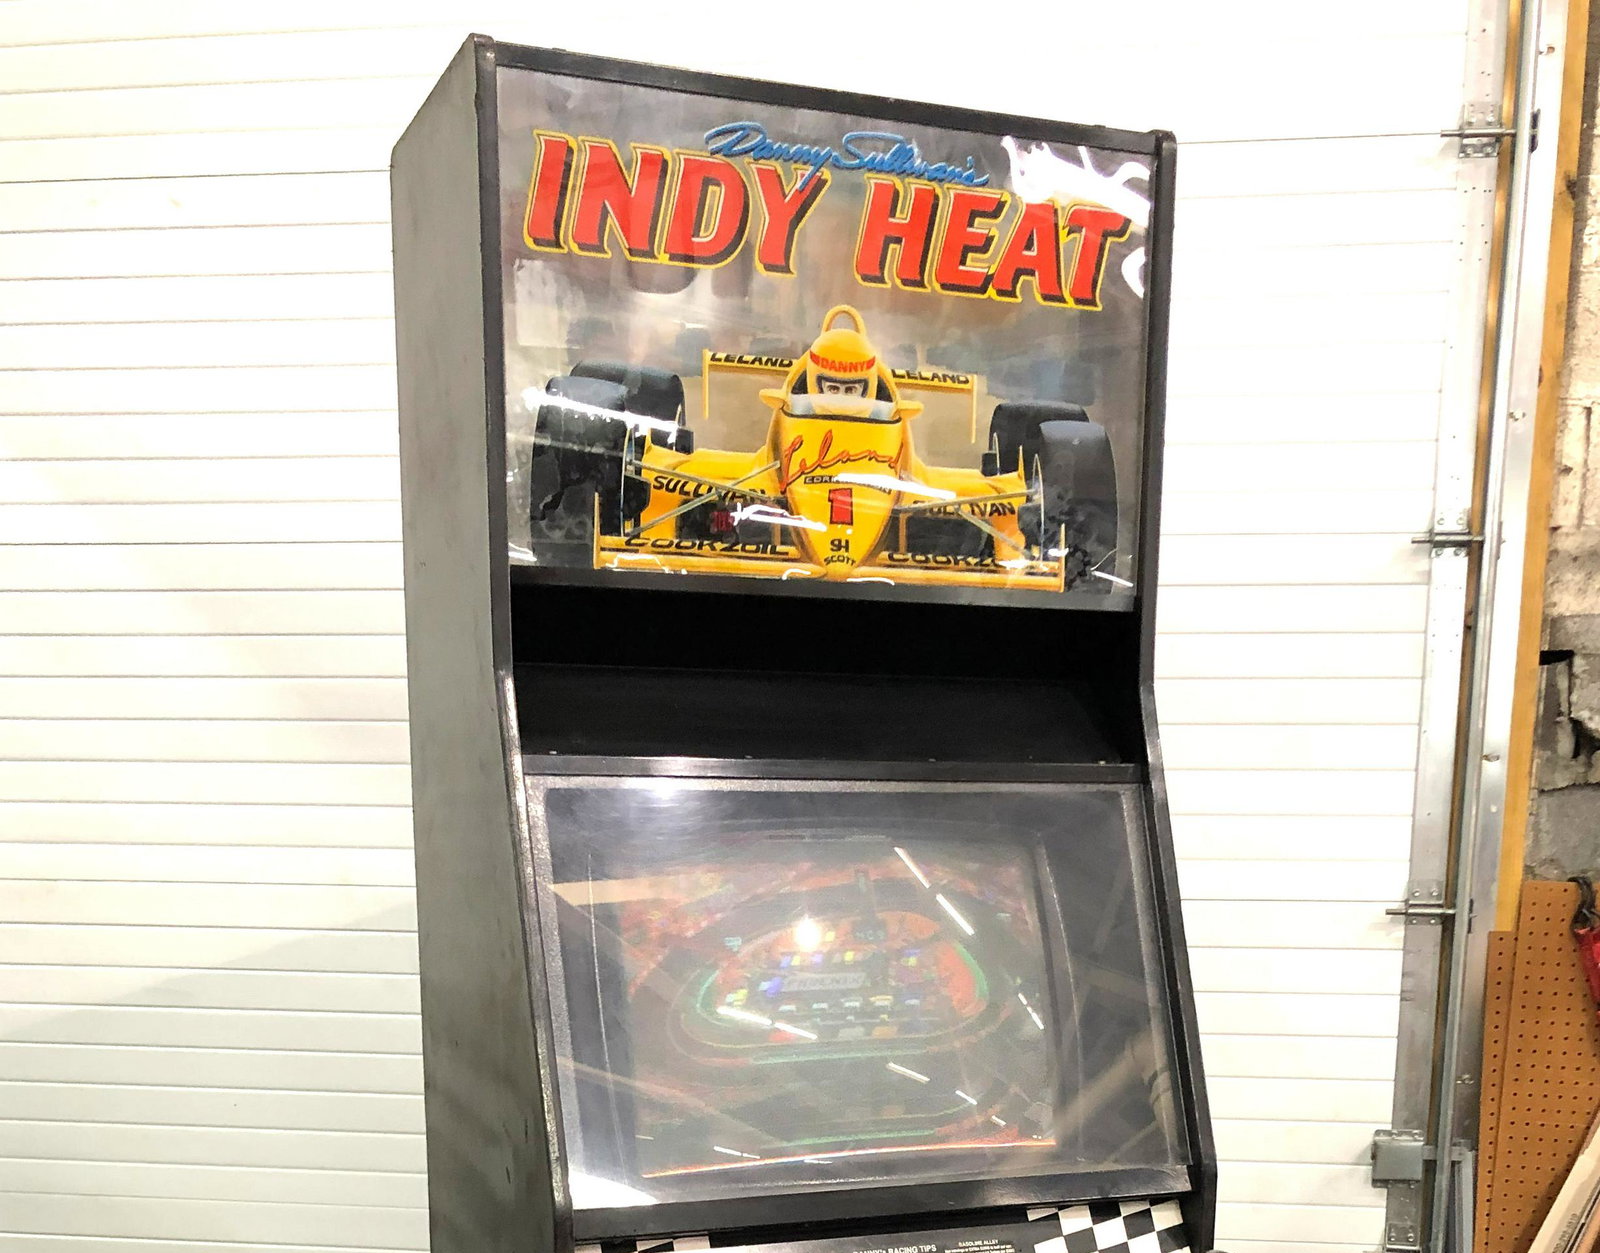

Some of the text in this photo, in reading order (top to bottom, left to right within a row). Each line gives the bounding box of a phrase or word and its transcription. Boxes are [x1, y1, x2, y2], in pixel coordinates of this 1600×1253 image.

[704, 121, 990, 189] Danny Sullivan's
[523, 130, 1134, 311] INDY HEAT
[710, 351, 793, 368] LELAND
[821, 358, 867, 373] DANNY
[891, 368, 970, 386] LELAND
[827, 487, 854, 526] 1
[823, 554, 857, 567] SCOTT
[919, 1244, 937, 1253] TIPS
[958, 1238, 998, 1247] GASOLINE ALLEY
